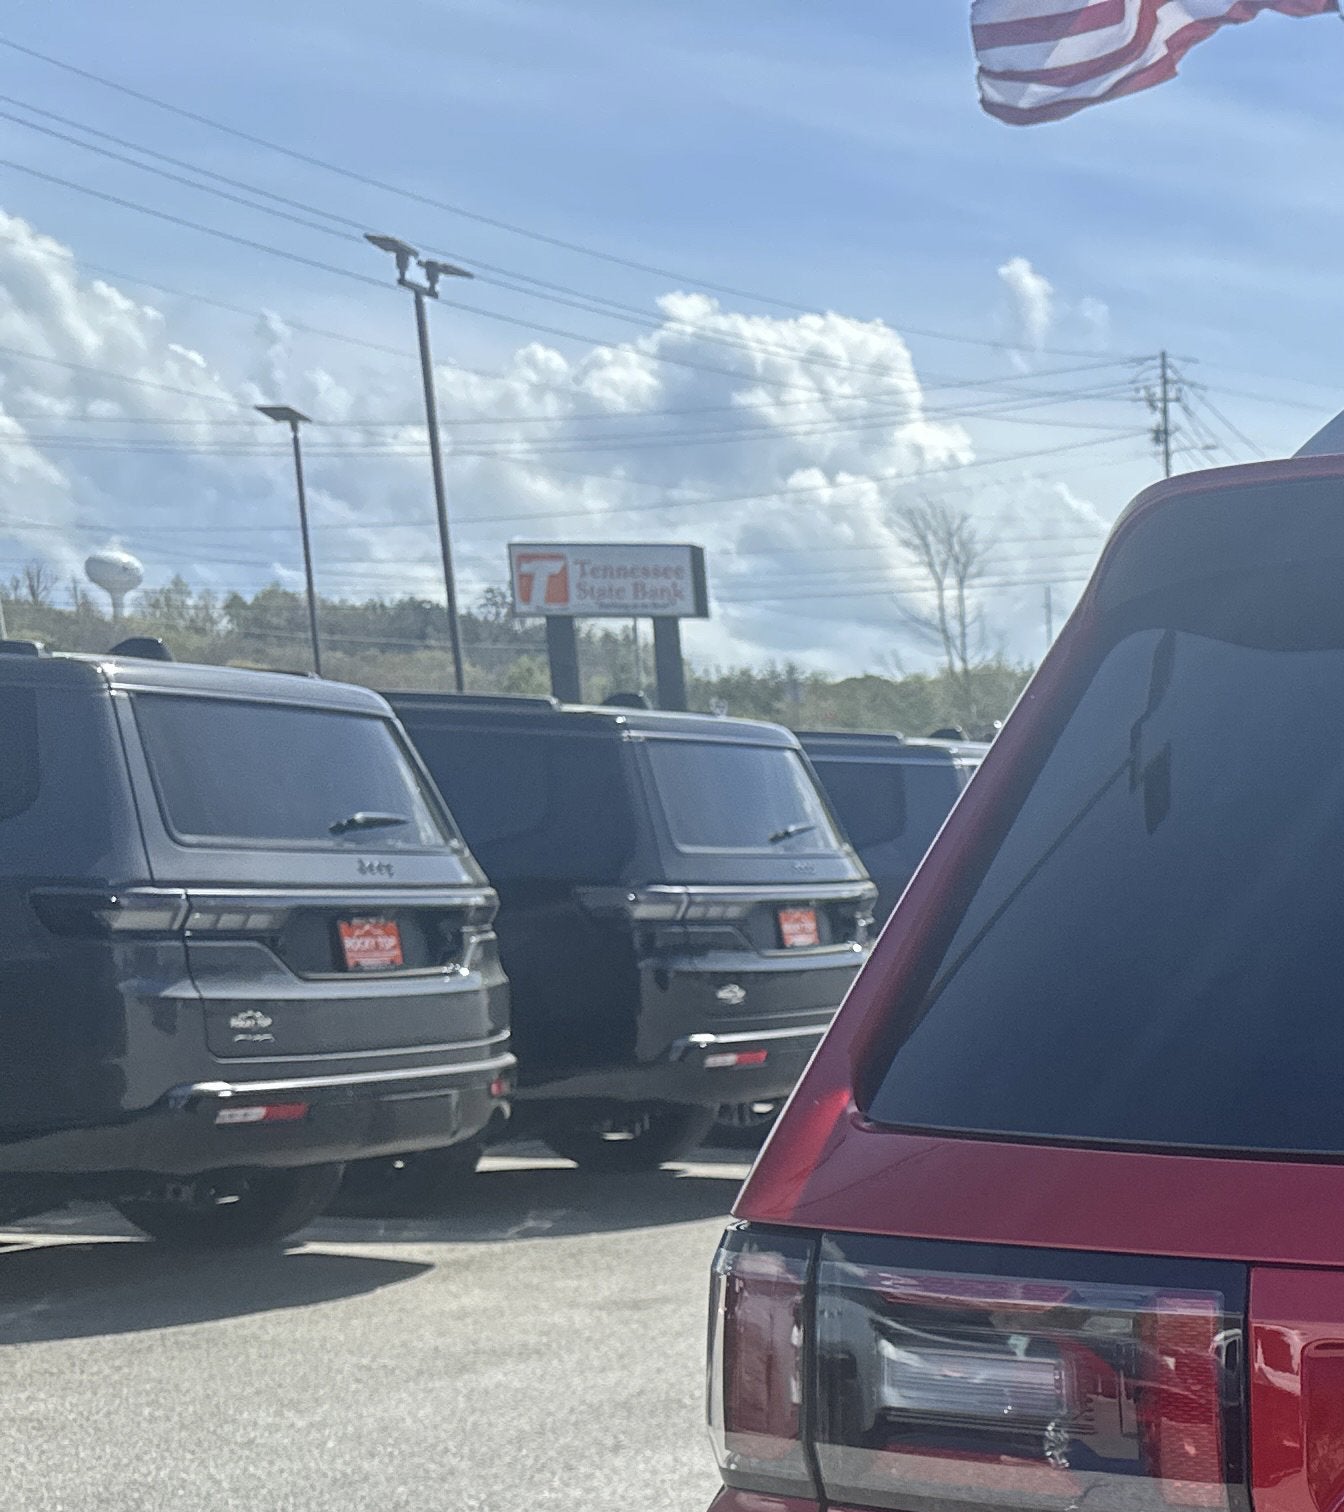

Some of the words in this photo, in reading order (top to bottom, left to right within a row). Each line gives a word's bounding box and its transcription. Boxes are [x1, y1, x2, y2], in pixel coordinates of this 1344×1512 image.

[573, 559, 685, 579] Tennessee
[575, 580, 625, 600] State
[631, 580, 684, 600] Bank
